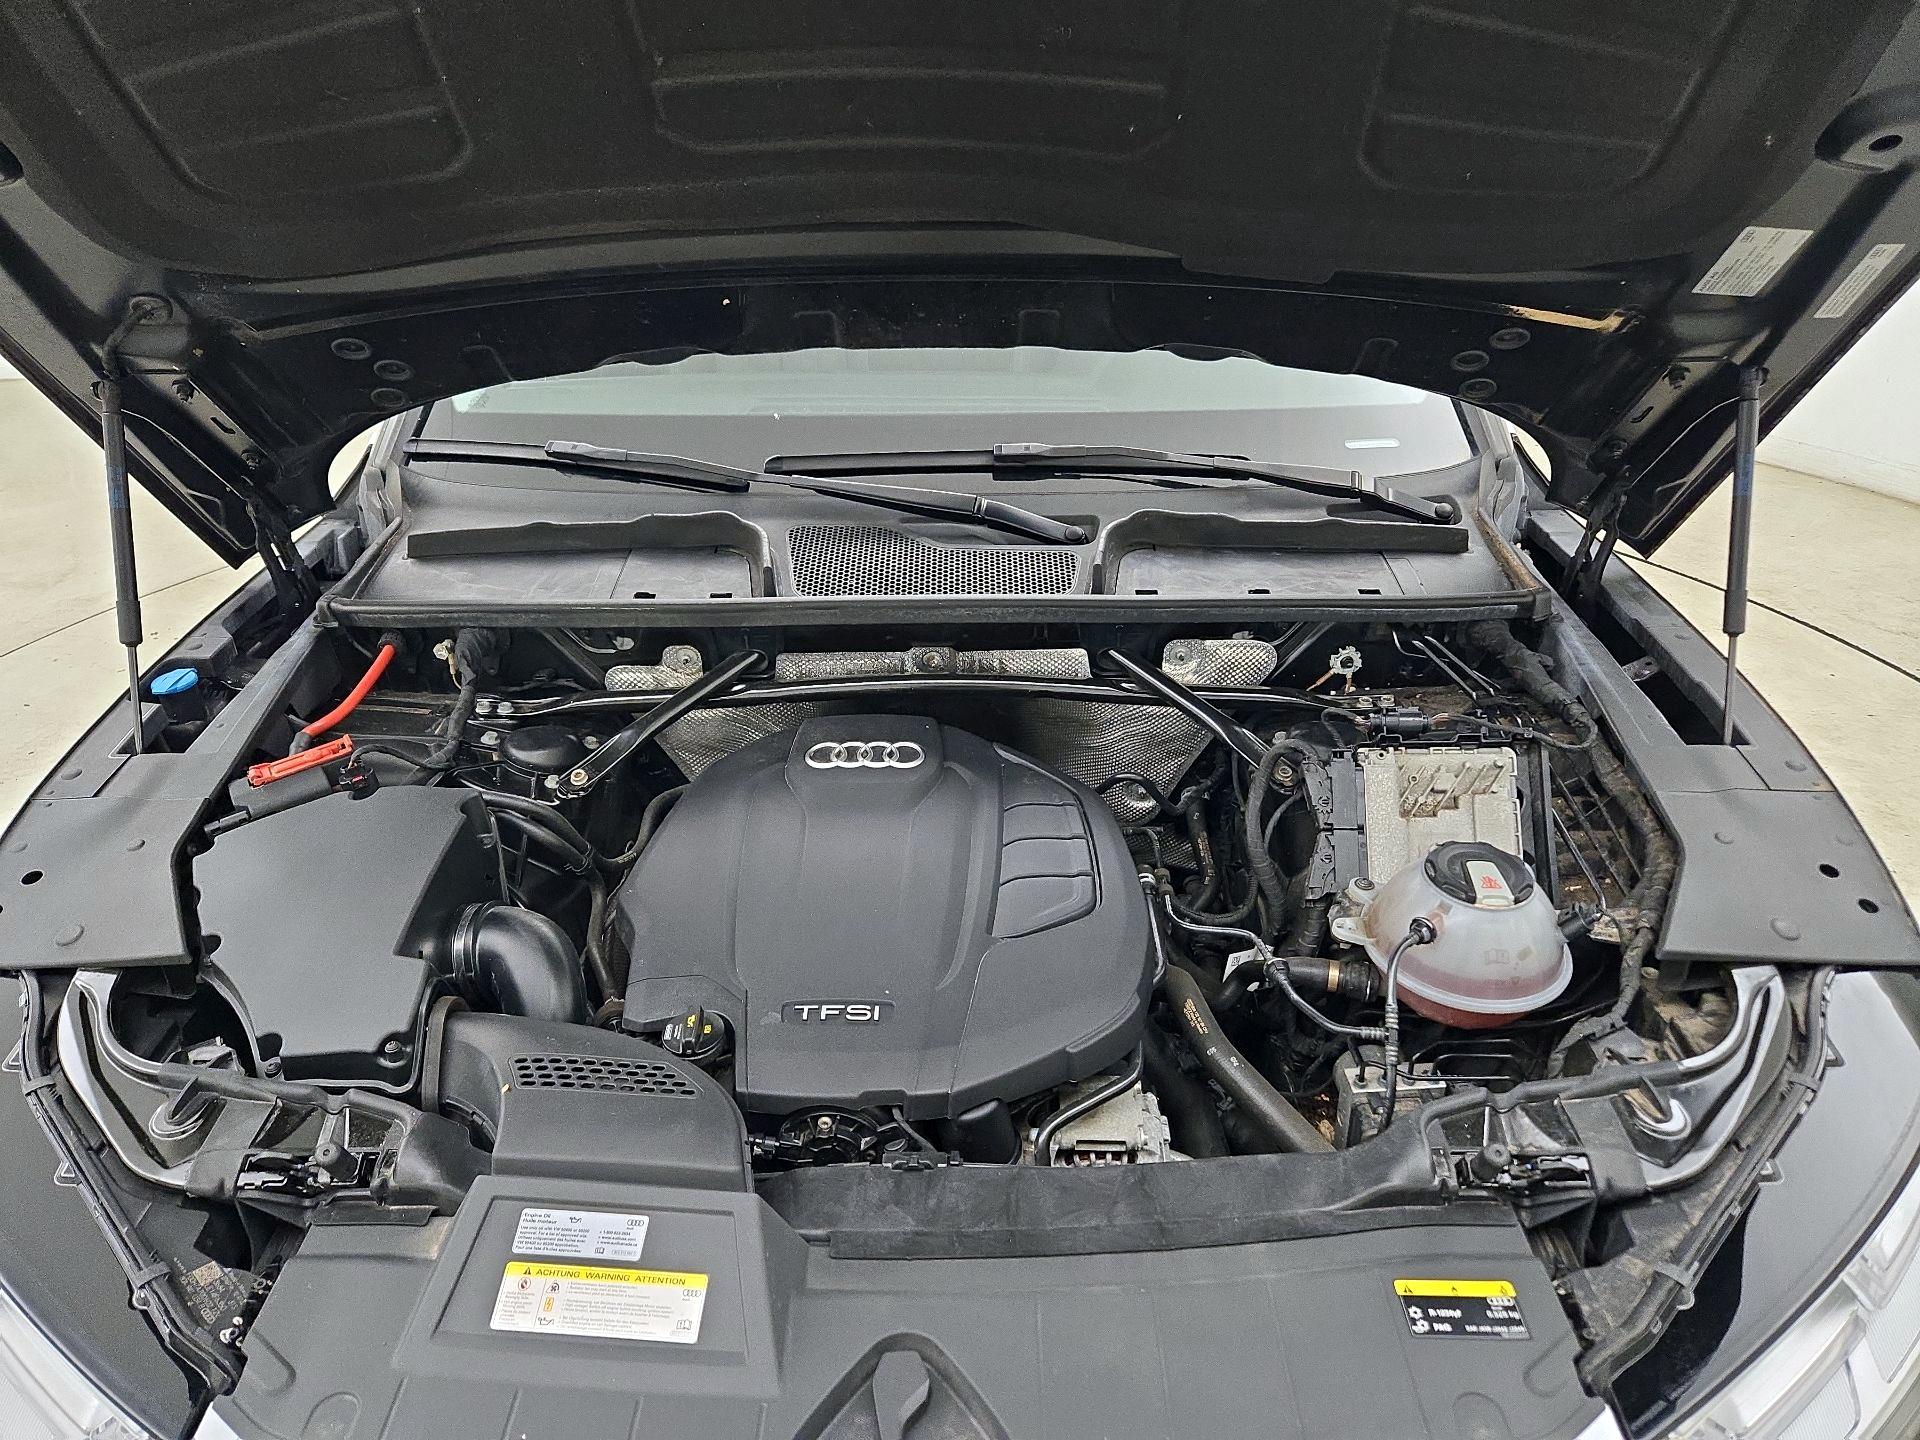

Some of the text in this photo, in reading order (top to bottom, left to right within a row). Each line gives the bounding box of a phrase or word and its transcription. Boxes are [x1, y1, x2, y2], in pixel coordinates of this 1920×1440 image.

[794, 1005, 880, 1021] TFSI
[536, 1268, 580, 1278] ACHTUNG
[586, 1272, 630, 1281] WARNING
[634, 1275, 686, 1285] ATTENTION
